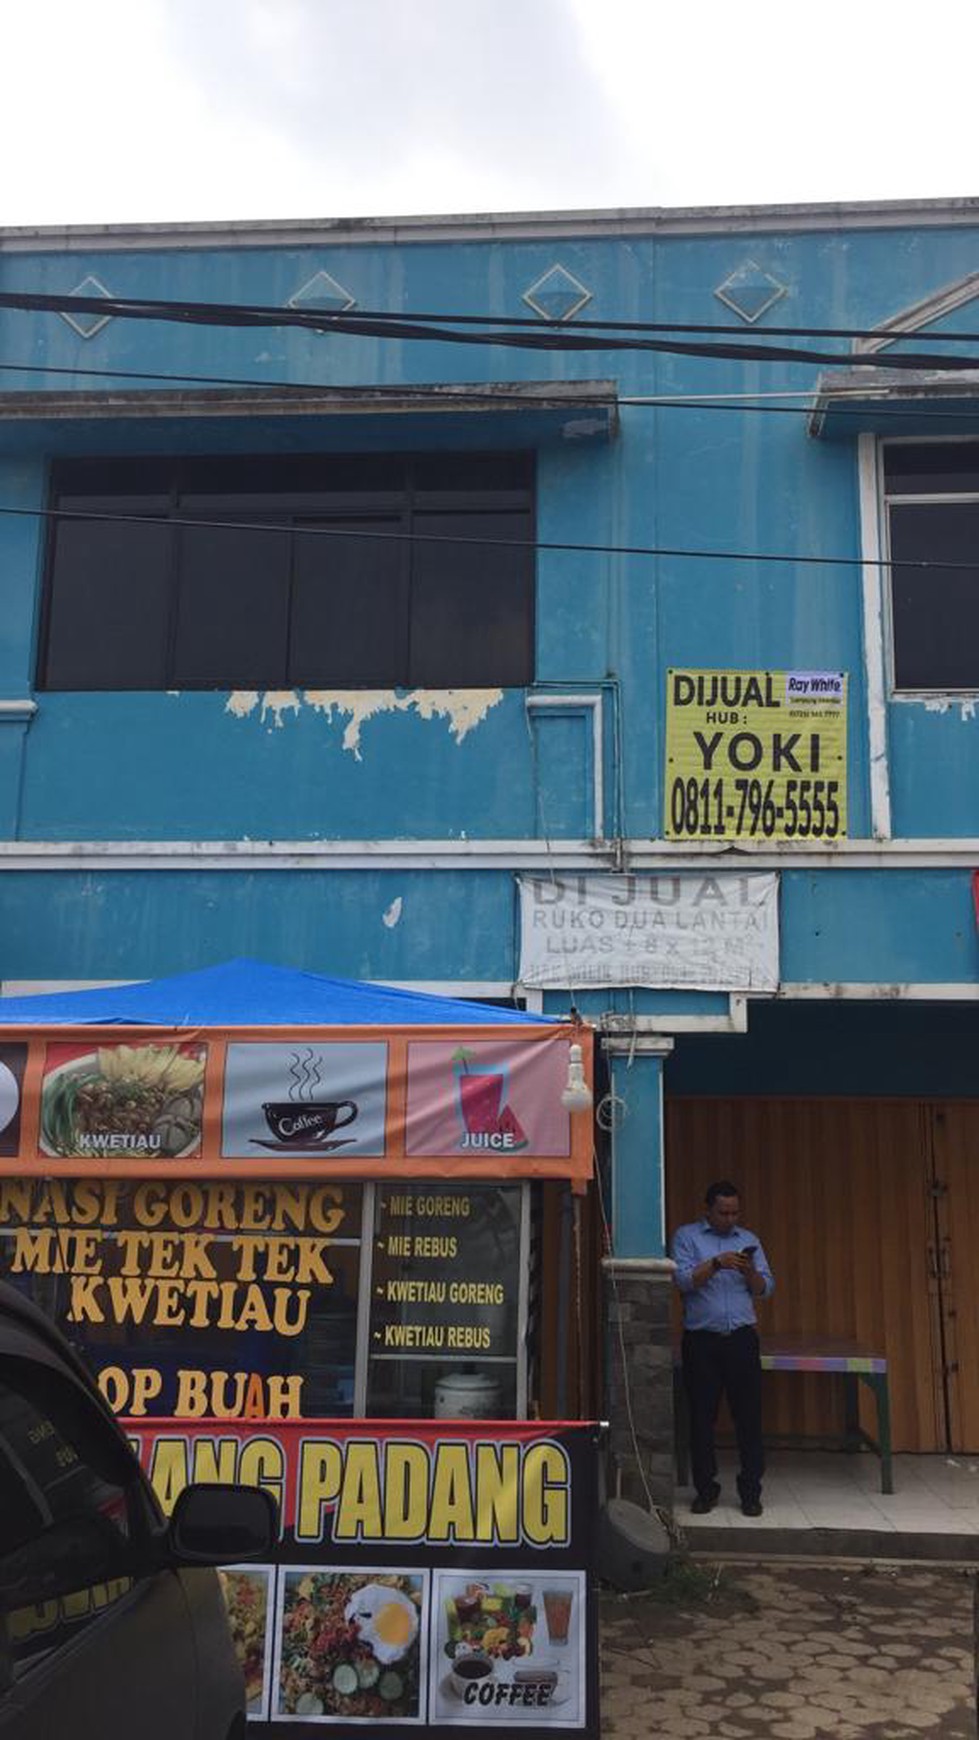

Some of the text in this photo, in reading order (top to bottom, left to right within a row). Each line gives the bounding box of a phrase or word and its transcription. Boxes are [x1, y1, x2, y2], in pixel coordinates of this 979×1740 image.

[673, 675, 781, 707] DIJUAL
[789, 677, 841, 693] Ray White
[693, 731, 820, 772] YOKI
[671, 776, 840, 837] 0811-796-5555
[532, 909, 769, 931] RUKO DUA LANTAI
[546, 935, 614, 954] LUAS
[278, 1114, 322, 1136] Coffee
[79, 1132, 161, 1150] KWETIAU
[461, 1131, 515, 1150] JUICE
[0, 1179, 346, 1233] NASI GORENG
[390, 1195, 470, 1217] MIE GORENG
[10, 1227, 334, 1284] MIE TEK TEK
[387, 1236, 458, 1258] MIE REBUS
[386, 1280, 504, 1305] KWETIAU GORENG
[67, 1276, 312, 1337] KWETIAU
[384, 1325, 491, 1349] KWETIAU REBUS
[98, 1365, 304, 1419] OP BUAH
[297, 1437, 571, 1547] PADANG
[463, 1681, 552, 1707] COFFEE
